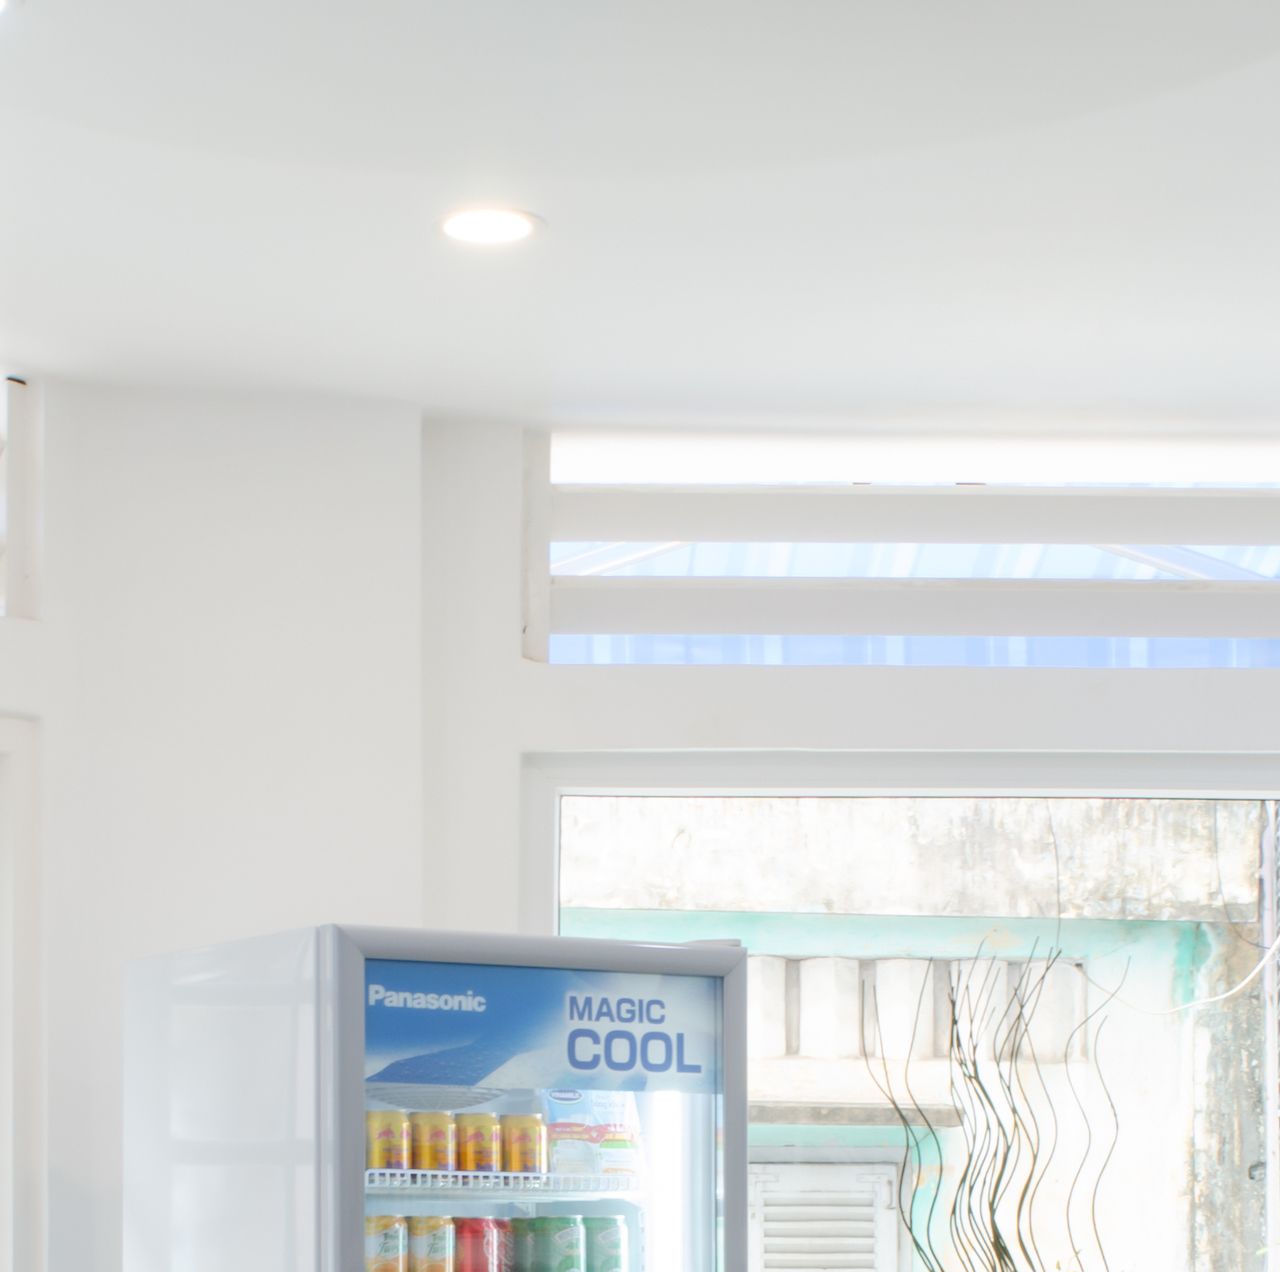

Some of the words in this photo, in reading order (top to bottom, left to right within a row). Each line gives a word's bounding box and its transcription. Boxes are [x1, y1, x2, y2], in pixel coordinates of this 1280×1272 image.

[368, 984, 486, 1013] Panasonic
[568, 995, 666, 1025] MAGIC
[567, 1028, 702, 1074] COOL
